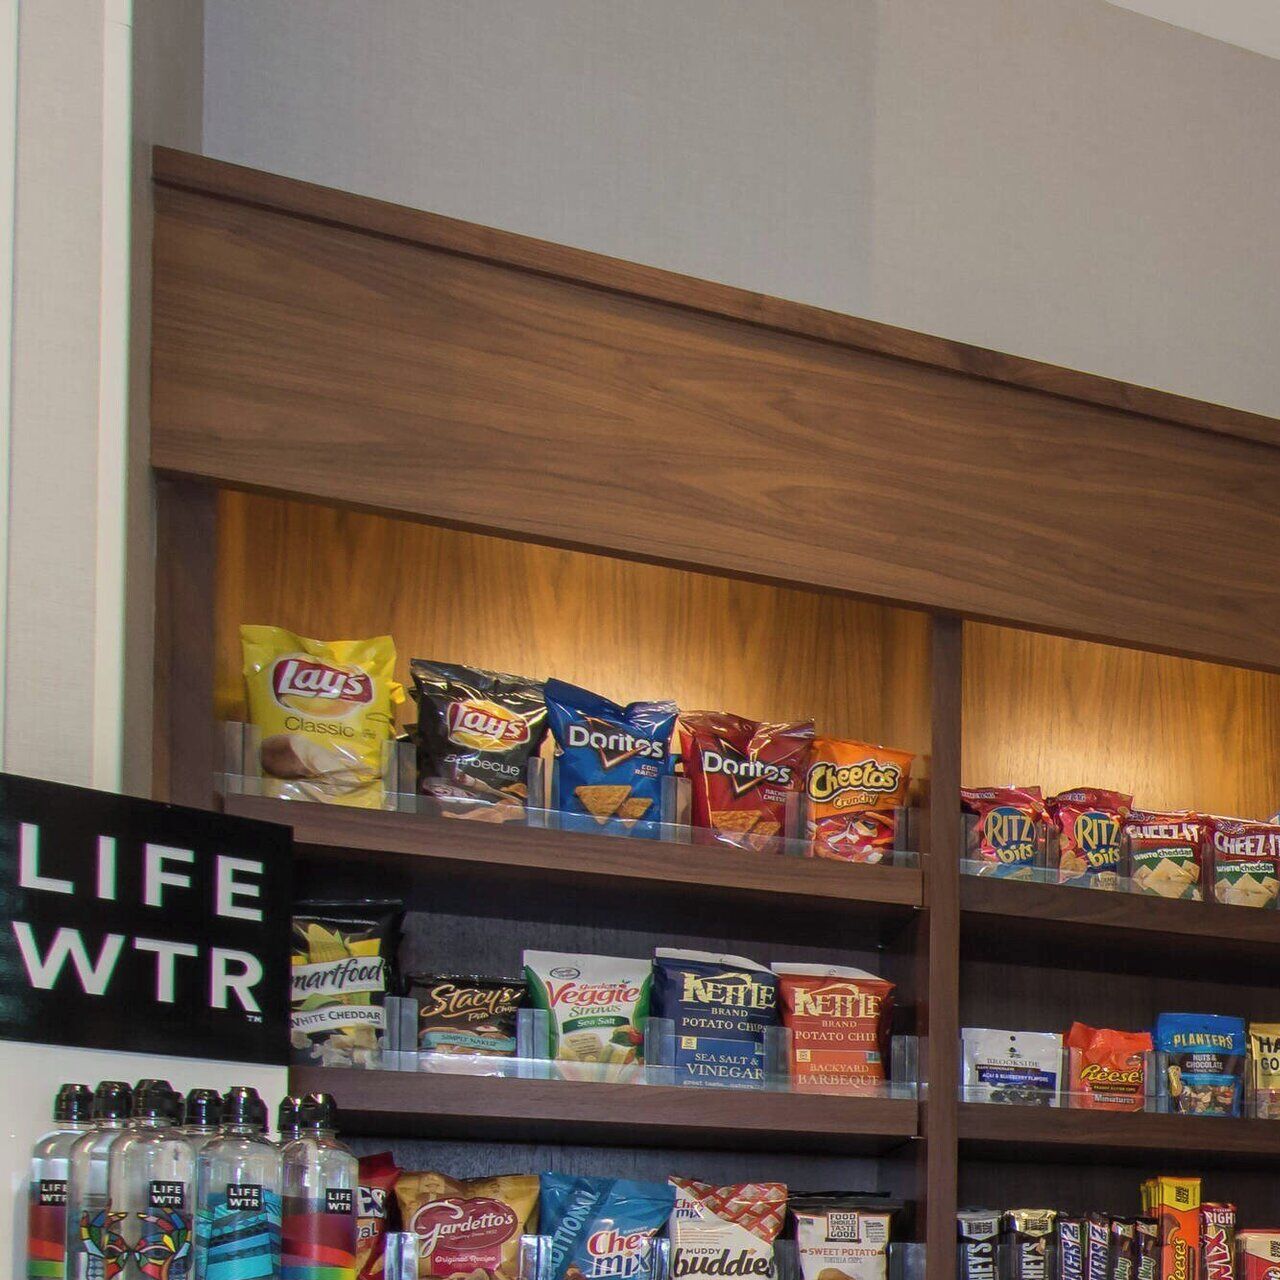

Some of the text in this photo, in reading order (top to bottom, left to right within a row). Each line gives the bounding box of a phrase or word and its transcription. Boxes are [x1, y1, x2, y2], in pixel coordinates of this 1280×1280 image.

[278, 660, 366, 699] Lay's
[285, 717, 354, 738] Classic
[450, 703, 527, 742] Lay's
[568, 725, 664, 758] Doritos
[703, 750, 792, 784] Doritos
[808, 760, 898, 802] Cheetos
[833, 792, 878, 809] Crunchy
[987, 812, 1033, 846] RITZ
[1076, 817, 1120, 851] RITZ
[997, 843, 1034, 864] bits
[1087, 849, 1120, 867] bits
[18, 822, 264, 922] LIFE
[11, 921, 263, 1013] WTR
[292, 959, 384, 990] martfood
[546, 981, 641, 1007] Veggie
[680, 972, 776, 1009] KETTLE
[420, 983, 515, 1018] Stacy's
[792, 983, 881, 1019] KETTLE
[329, 1009, 381, 1021] CHEDDAR
[711, 1007, 748, 1017] BRAND
[577, 1017, 616, 1027] Sea Salt
[682, 1017, 767, 1033] POTATO CHIPS
[822, 1020, 857, 1029] BRAND
[795, 1030, 844, 1042] POTATO
[1173, 1033, 1233, 1050] PLANTERS
[695, 1053, 759, 1066] SEA SALT &
[809, 1063, 869, 1073] BACKYARD
[987, 1058, 1040, 1067] BROOKSIDE
[1186, 1061, 1223, 1069] CHOCOLATE
[686, 1063, 764, 1081] VINEGAR
[798, 1073, 882, 1087] BARBEQUE
[153, 1185, 181, 1194] LIFE
[230, 1188, 259, 1197] LIFE
[328, 1192, 351, 1201] LIFE
[153, 1195, 182, 1205] WTR
[229, 1197, 260, 1207] WTR
[327, 1202, 351, 1211] WTR
[410, 1201, 514, 1257] Gardetto's
[830, 1231, 856, 1239] GOOD
[469, 1255, 496, 1265] Recipe
[808, 1248, 877, 1257] SWEET POTATO
[594, 1250, 651, 1279] mix
[674, 1248, 773, 1278] buddies
